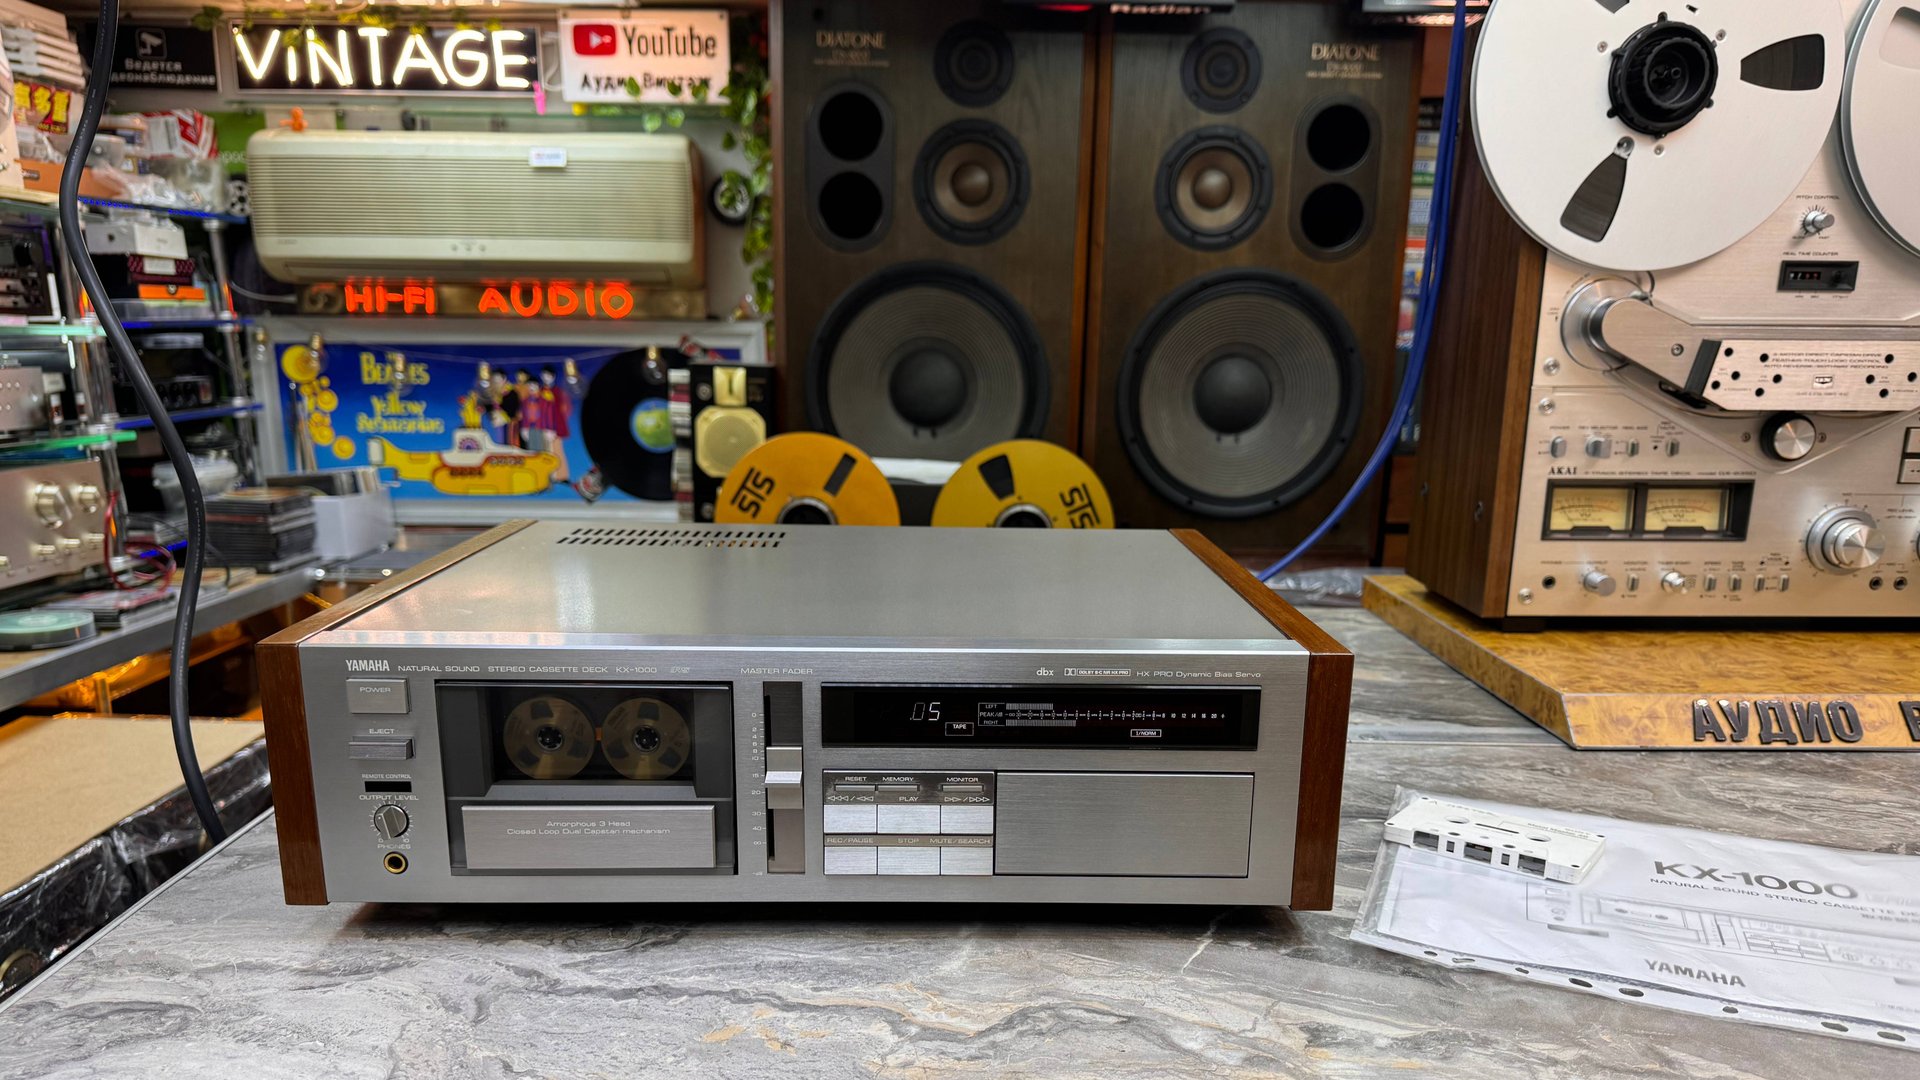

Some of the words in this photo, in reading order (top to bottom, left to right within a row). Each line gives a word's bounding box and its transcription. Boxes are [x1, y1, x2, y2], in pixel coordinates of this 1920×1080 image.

[623, 24, 717, 58] YouTube
[816, 30, 886, 49] DIATONE
[1311, 43, 1378, 61] DIATONE
[124, 57, 182, 71] Ведется
[111, 71, 216, 86] деонаблюдение
[581, 73, 632, 93] Ауди
[344, 284, 435, 315] HI-FI
[478, 284, 634, 319] AUDIO
[1548, 466, 1577, 476] AKAI
[345, 660, 390, 672] YAMAHA
[488, 665, 526, 673] STEREO
[616, 666, 658, 674] KX-1000
[1036, 667, 1054, 676] dbx
[1176, 671, 1212, 679] Dynamic
[1693, 699, 1864, 744] АУДИО
[539, 828, 560, 836] Loop
[584, 828, 619, 836] Capstan
[546, 820, 597, 828] Amorphous
[1653, 860, 1859, 899] KX-1000
[1650, 878, 1709, 890] NATURAL
[1713, 886, 1760, 897] SOUND
[1764, 893, 1818, 905] STEREO
[1823, 901, 1896, 916] CASSETTE
[1644, 958, 1746, 988] YAMAHA
